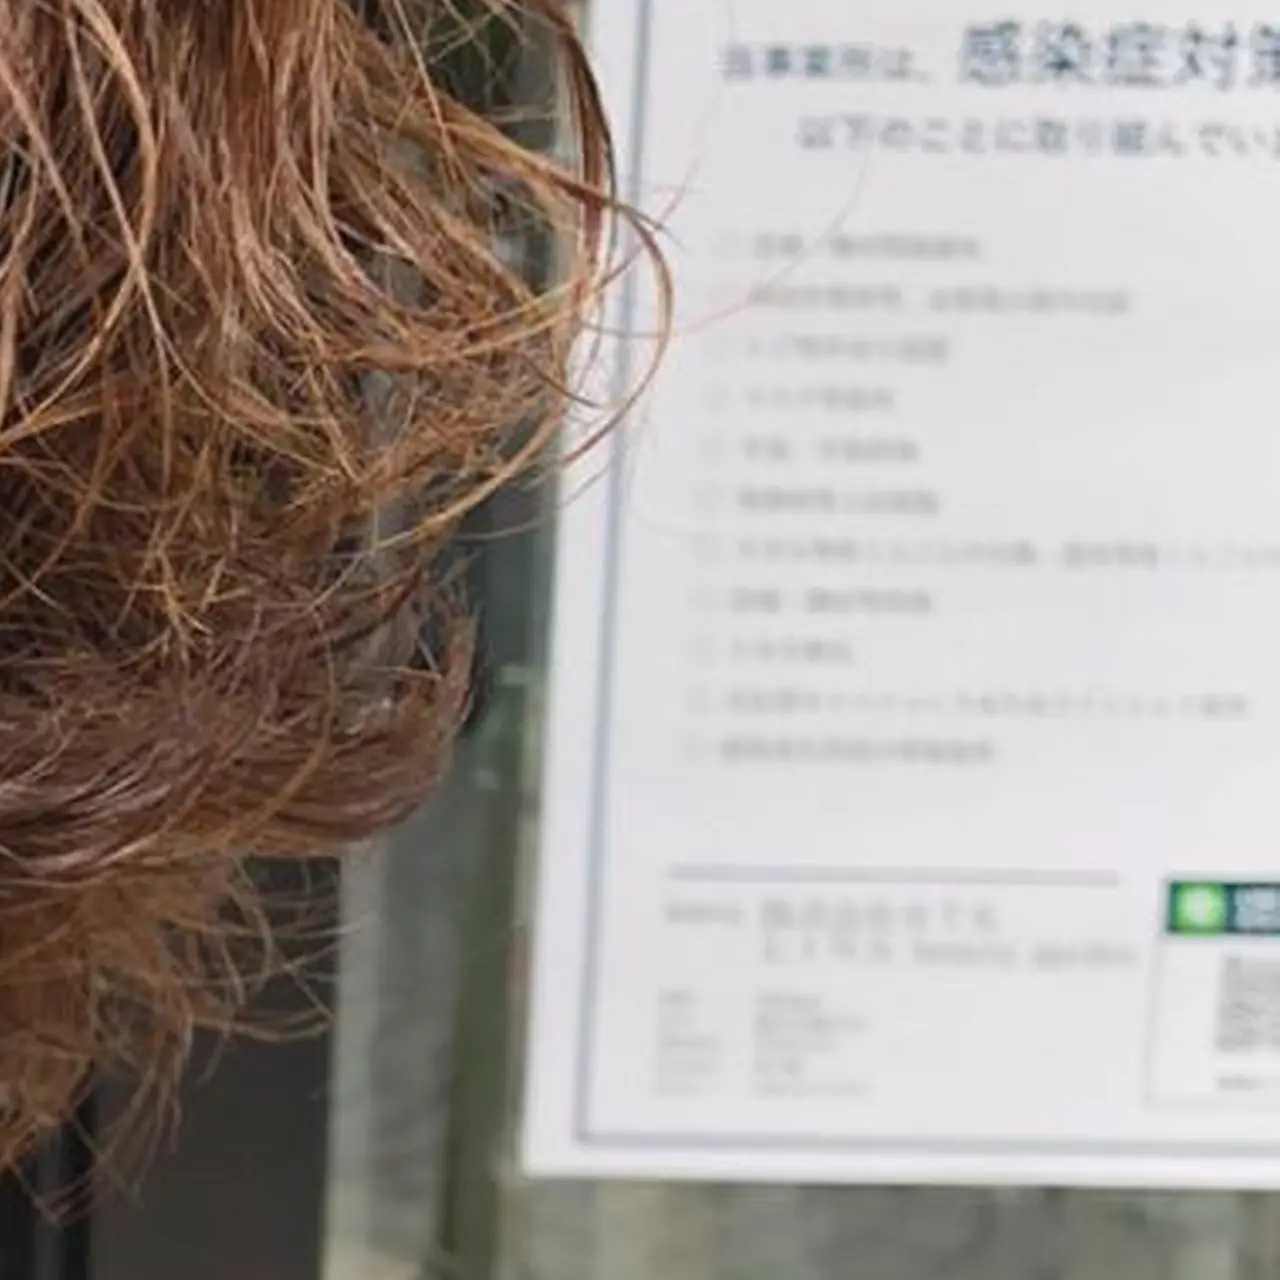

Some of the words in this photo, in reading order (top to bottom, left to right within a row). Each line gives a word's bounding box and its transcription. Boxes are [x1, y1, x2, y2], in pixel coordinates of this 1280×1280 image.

[797, 114, 1280, 157] 以下のことに取り組んでい
